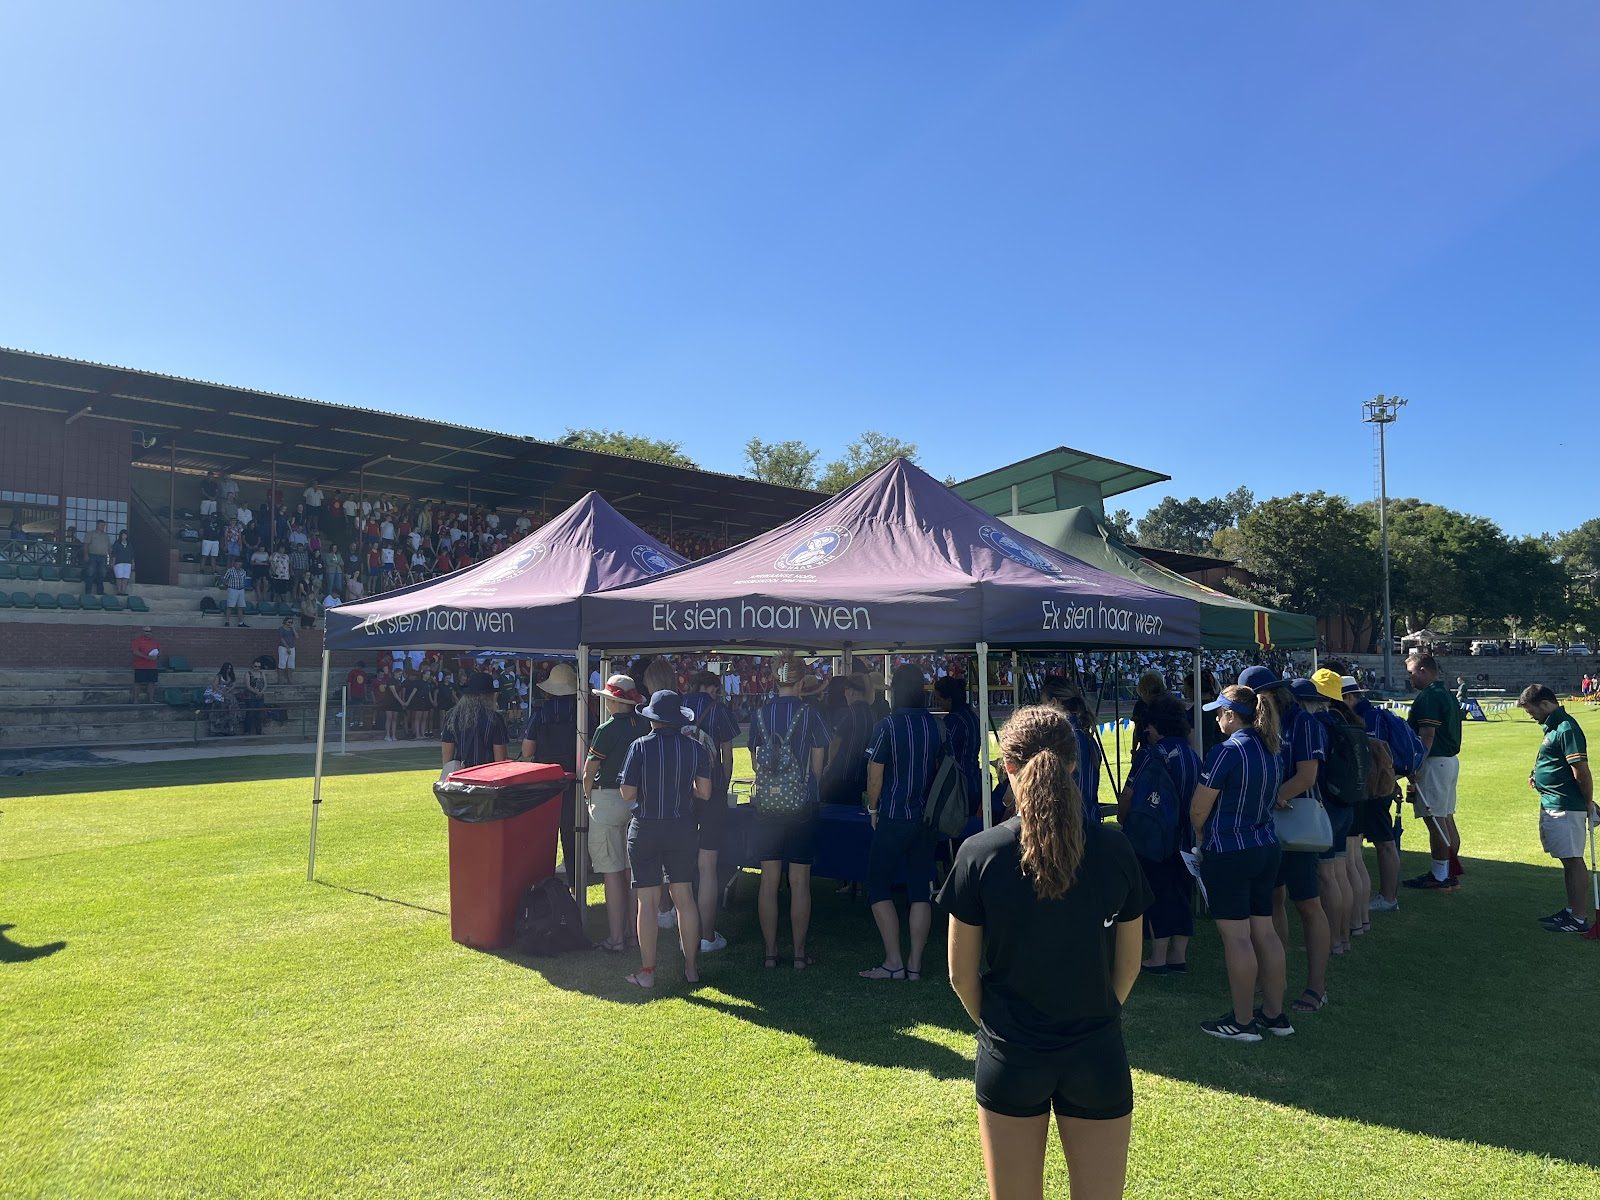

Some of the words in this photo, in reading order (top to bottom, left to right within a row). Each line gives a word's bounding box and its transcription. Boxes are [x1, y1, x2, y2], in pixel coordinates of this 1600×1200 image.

[365, 613, 384, 636] Ek
[387, 613, 421, 634] sien
[426, 608, 468, 631] haar
[473, 611, 513, 633] wen
[652, 604, 677, 631] Ek
[683, 603, 732, 631] sien
[741, 600, 802, 630] haar
[810, 606, 871, 630] wen
[1042, 600, 1060, 630] Ek
[1063, 601, 1094, 630] sien
[1098, 601, 1133, 632] haar
[1135, 612, 1163, 636] wen
